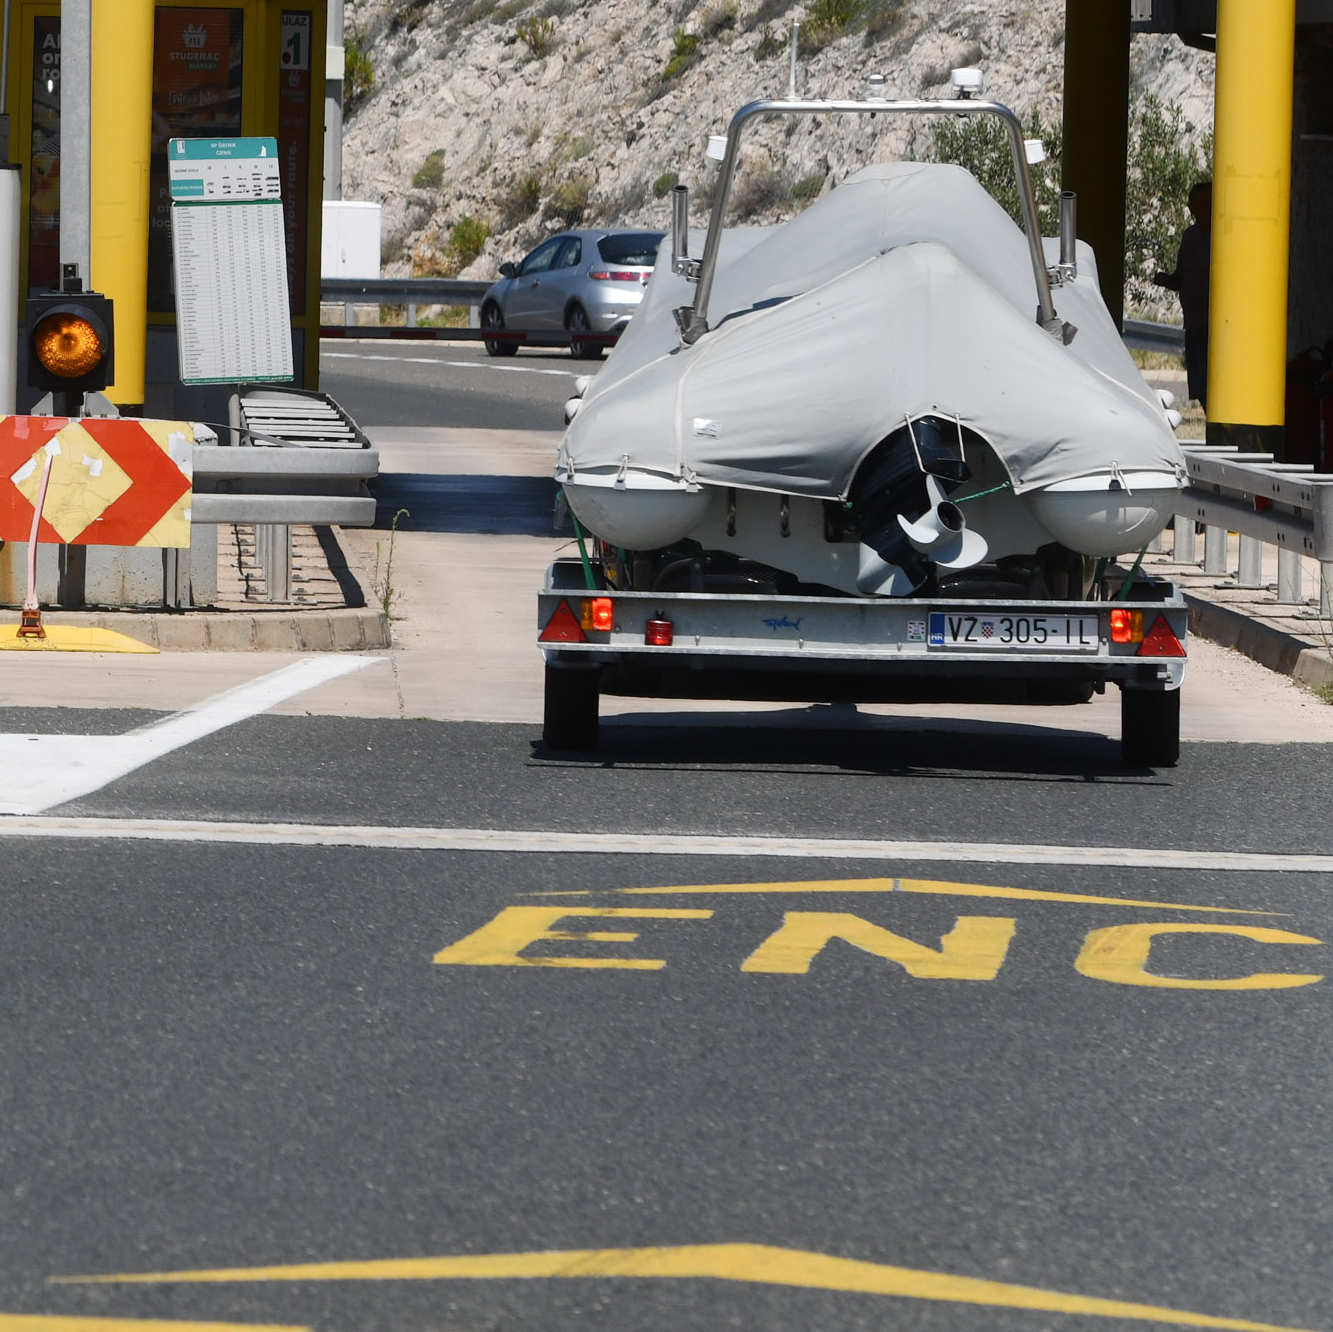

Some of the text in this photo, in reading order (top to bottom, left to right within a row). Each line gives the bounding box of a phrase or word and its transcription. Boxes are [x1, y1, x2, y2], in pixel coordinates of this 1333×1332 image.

[282, 17, 307, 26] ULAZ
[169, 52, 220, 61] STUDENAC
[287, 31, 301, 65] 1
[931, 632, 943, 641] HR
[947, 617, 979, 643] VZ
[998, 618, 1091, 645] 305-IL
[432, 905, 1325, 991] ENC
